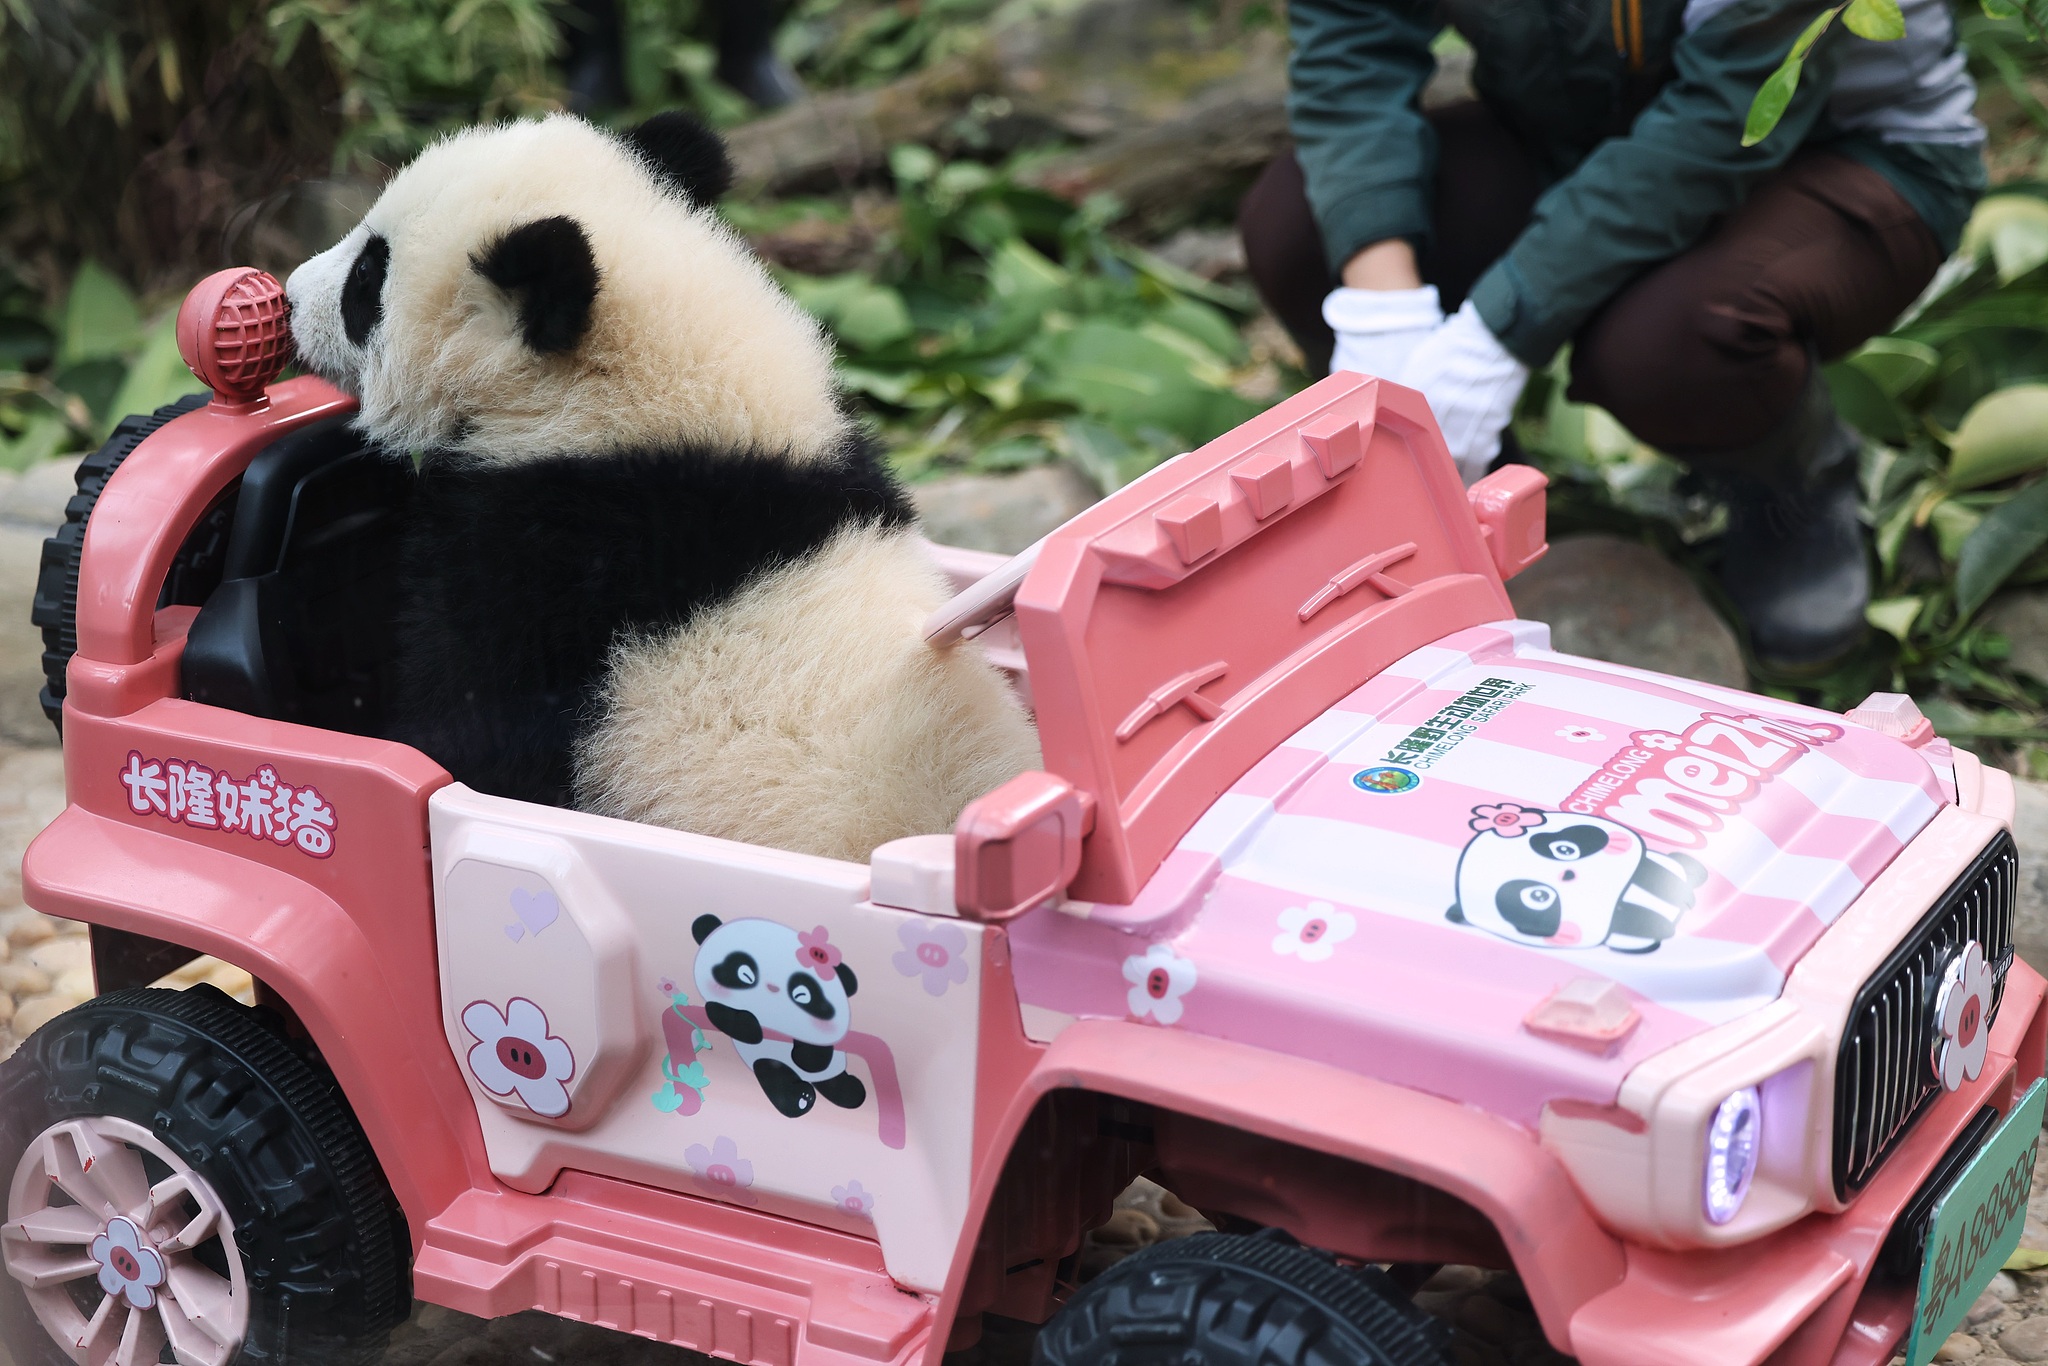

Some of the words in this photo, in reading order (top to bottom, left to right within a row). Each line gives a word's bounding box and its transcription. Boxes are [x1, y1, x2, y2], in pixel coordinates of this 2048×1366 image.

[1379, 677, 1516, 765] 长隆野生动物世界
[1413, 724, 1478, 770] CHIMELONG
[1471, 698, 1513, 723] SAFARI
[1502, 682, 1537, 700] PARK
[121, 752, 336, 857] 长隆妹猪
[1568, 749, 1654, 814] CHIMELONG
